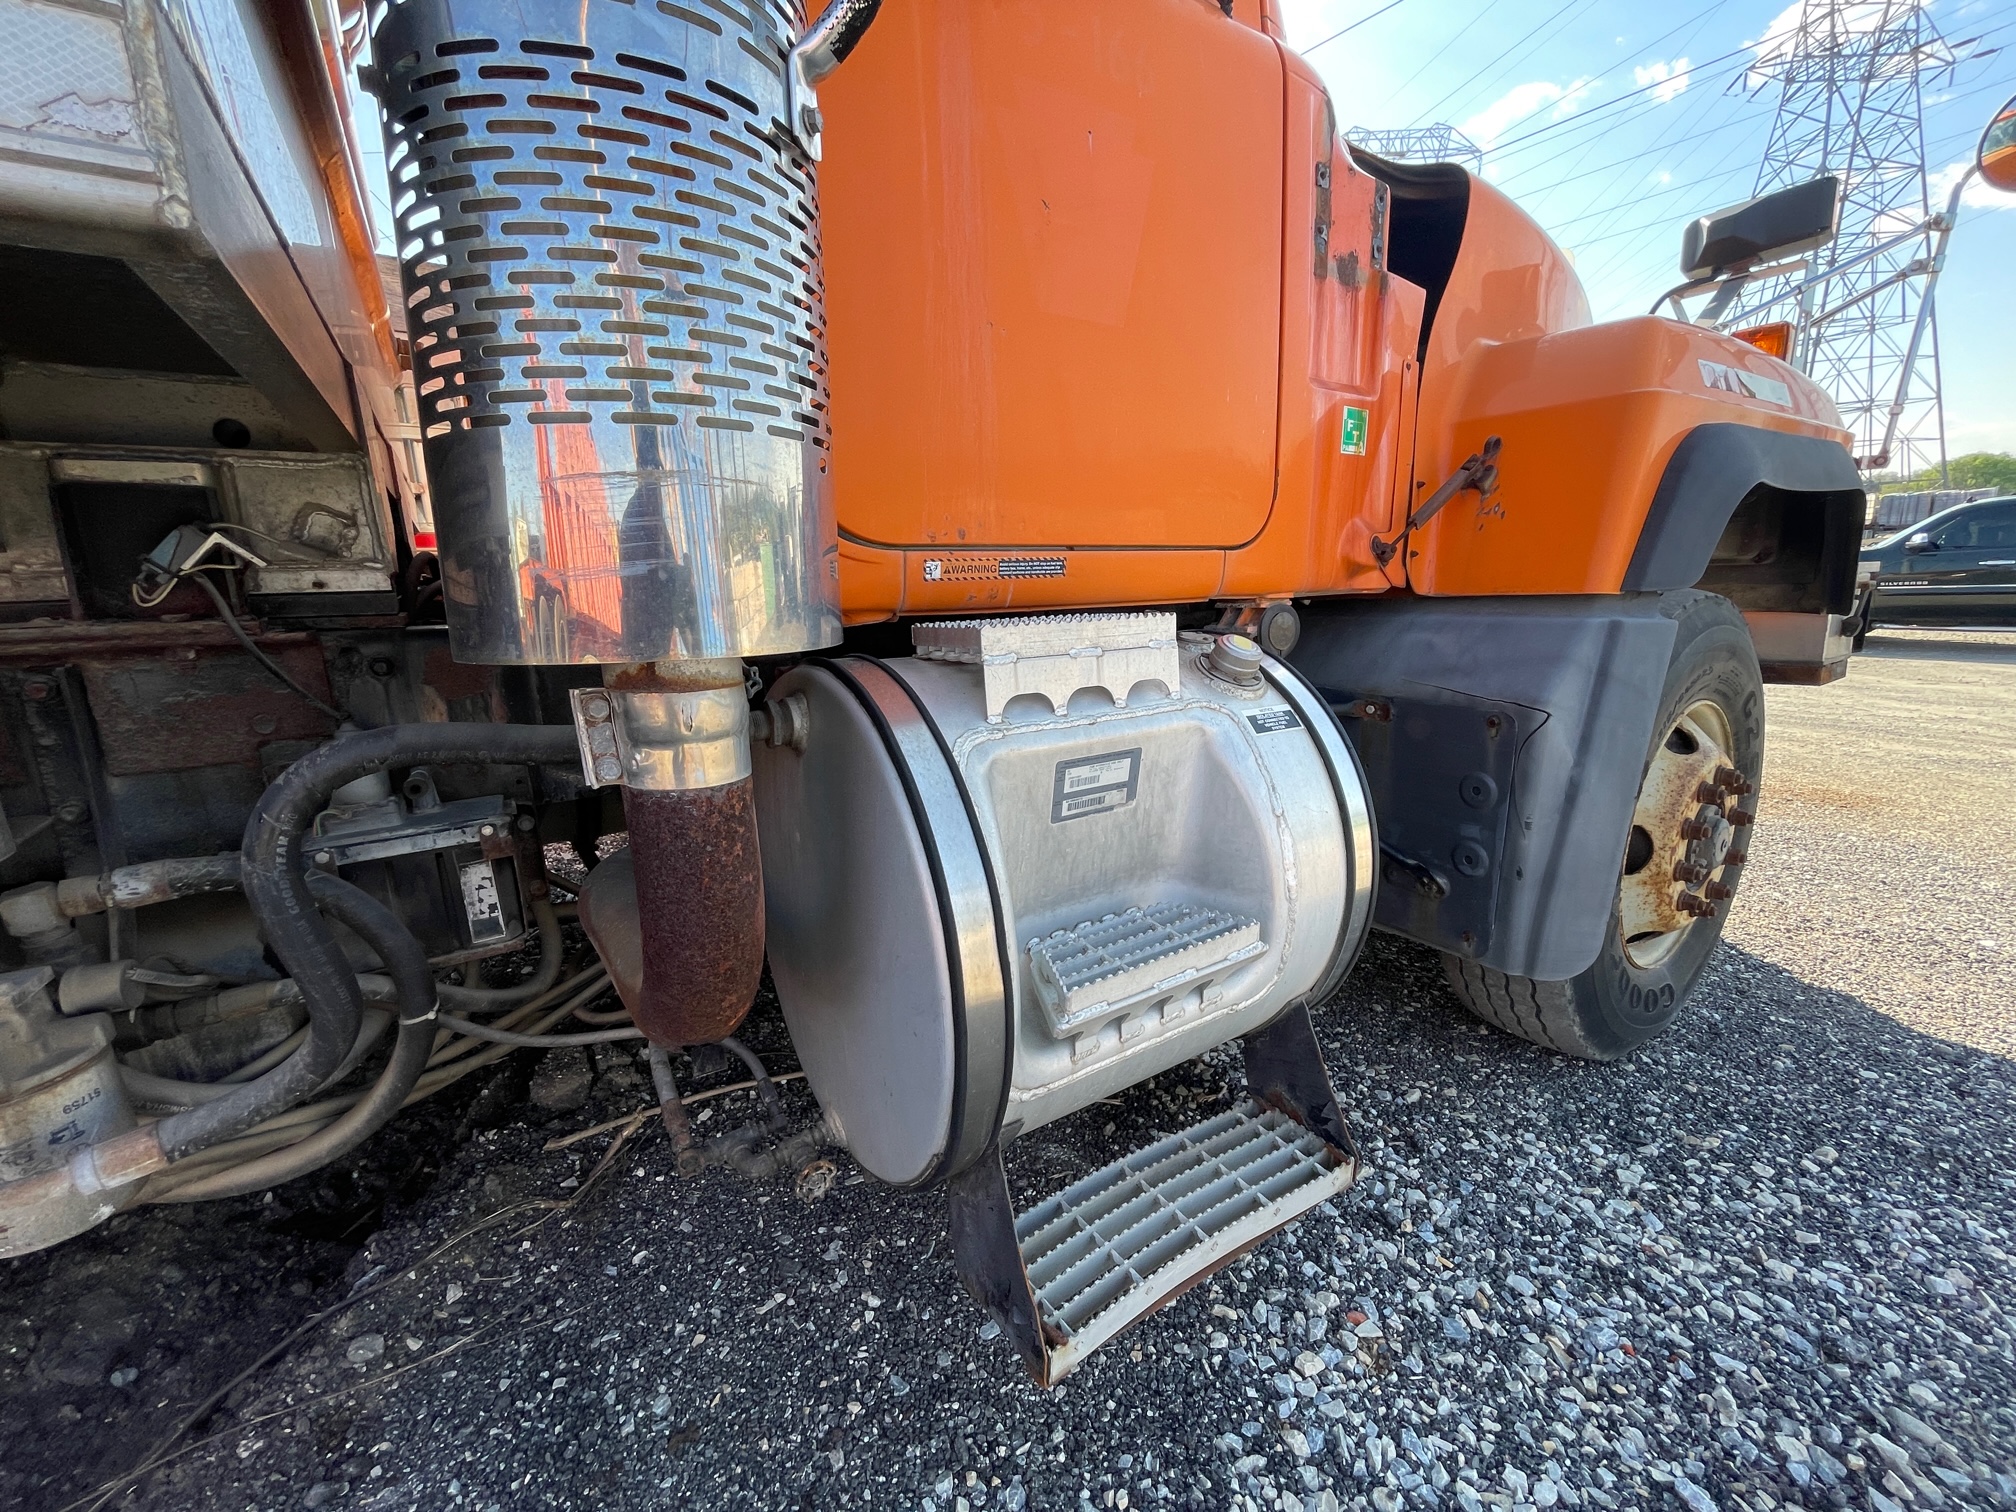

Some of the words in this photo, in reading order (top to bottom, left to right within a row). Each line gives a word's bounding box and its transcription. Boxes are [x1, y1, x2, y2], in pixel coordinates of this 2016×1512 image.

[951, 564, 998, 576] WARNING
[272, 836, 300, 915] GOODYEAR
[62, 1087, 102, 1115] 51759
